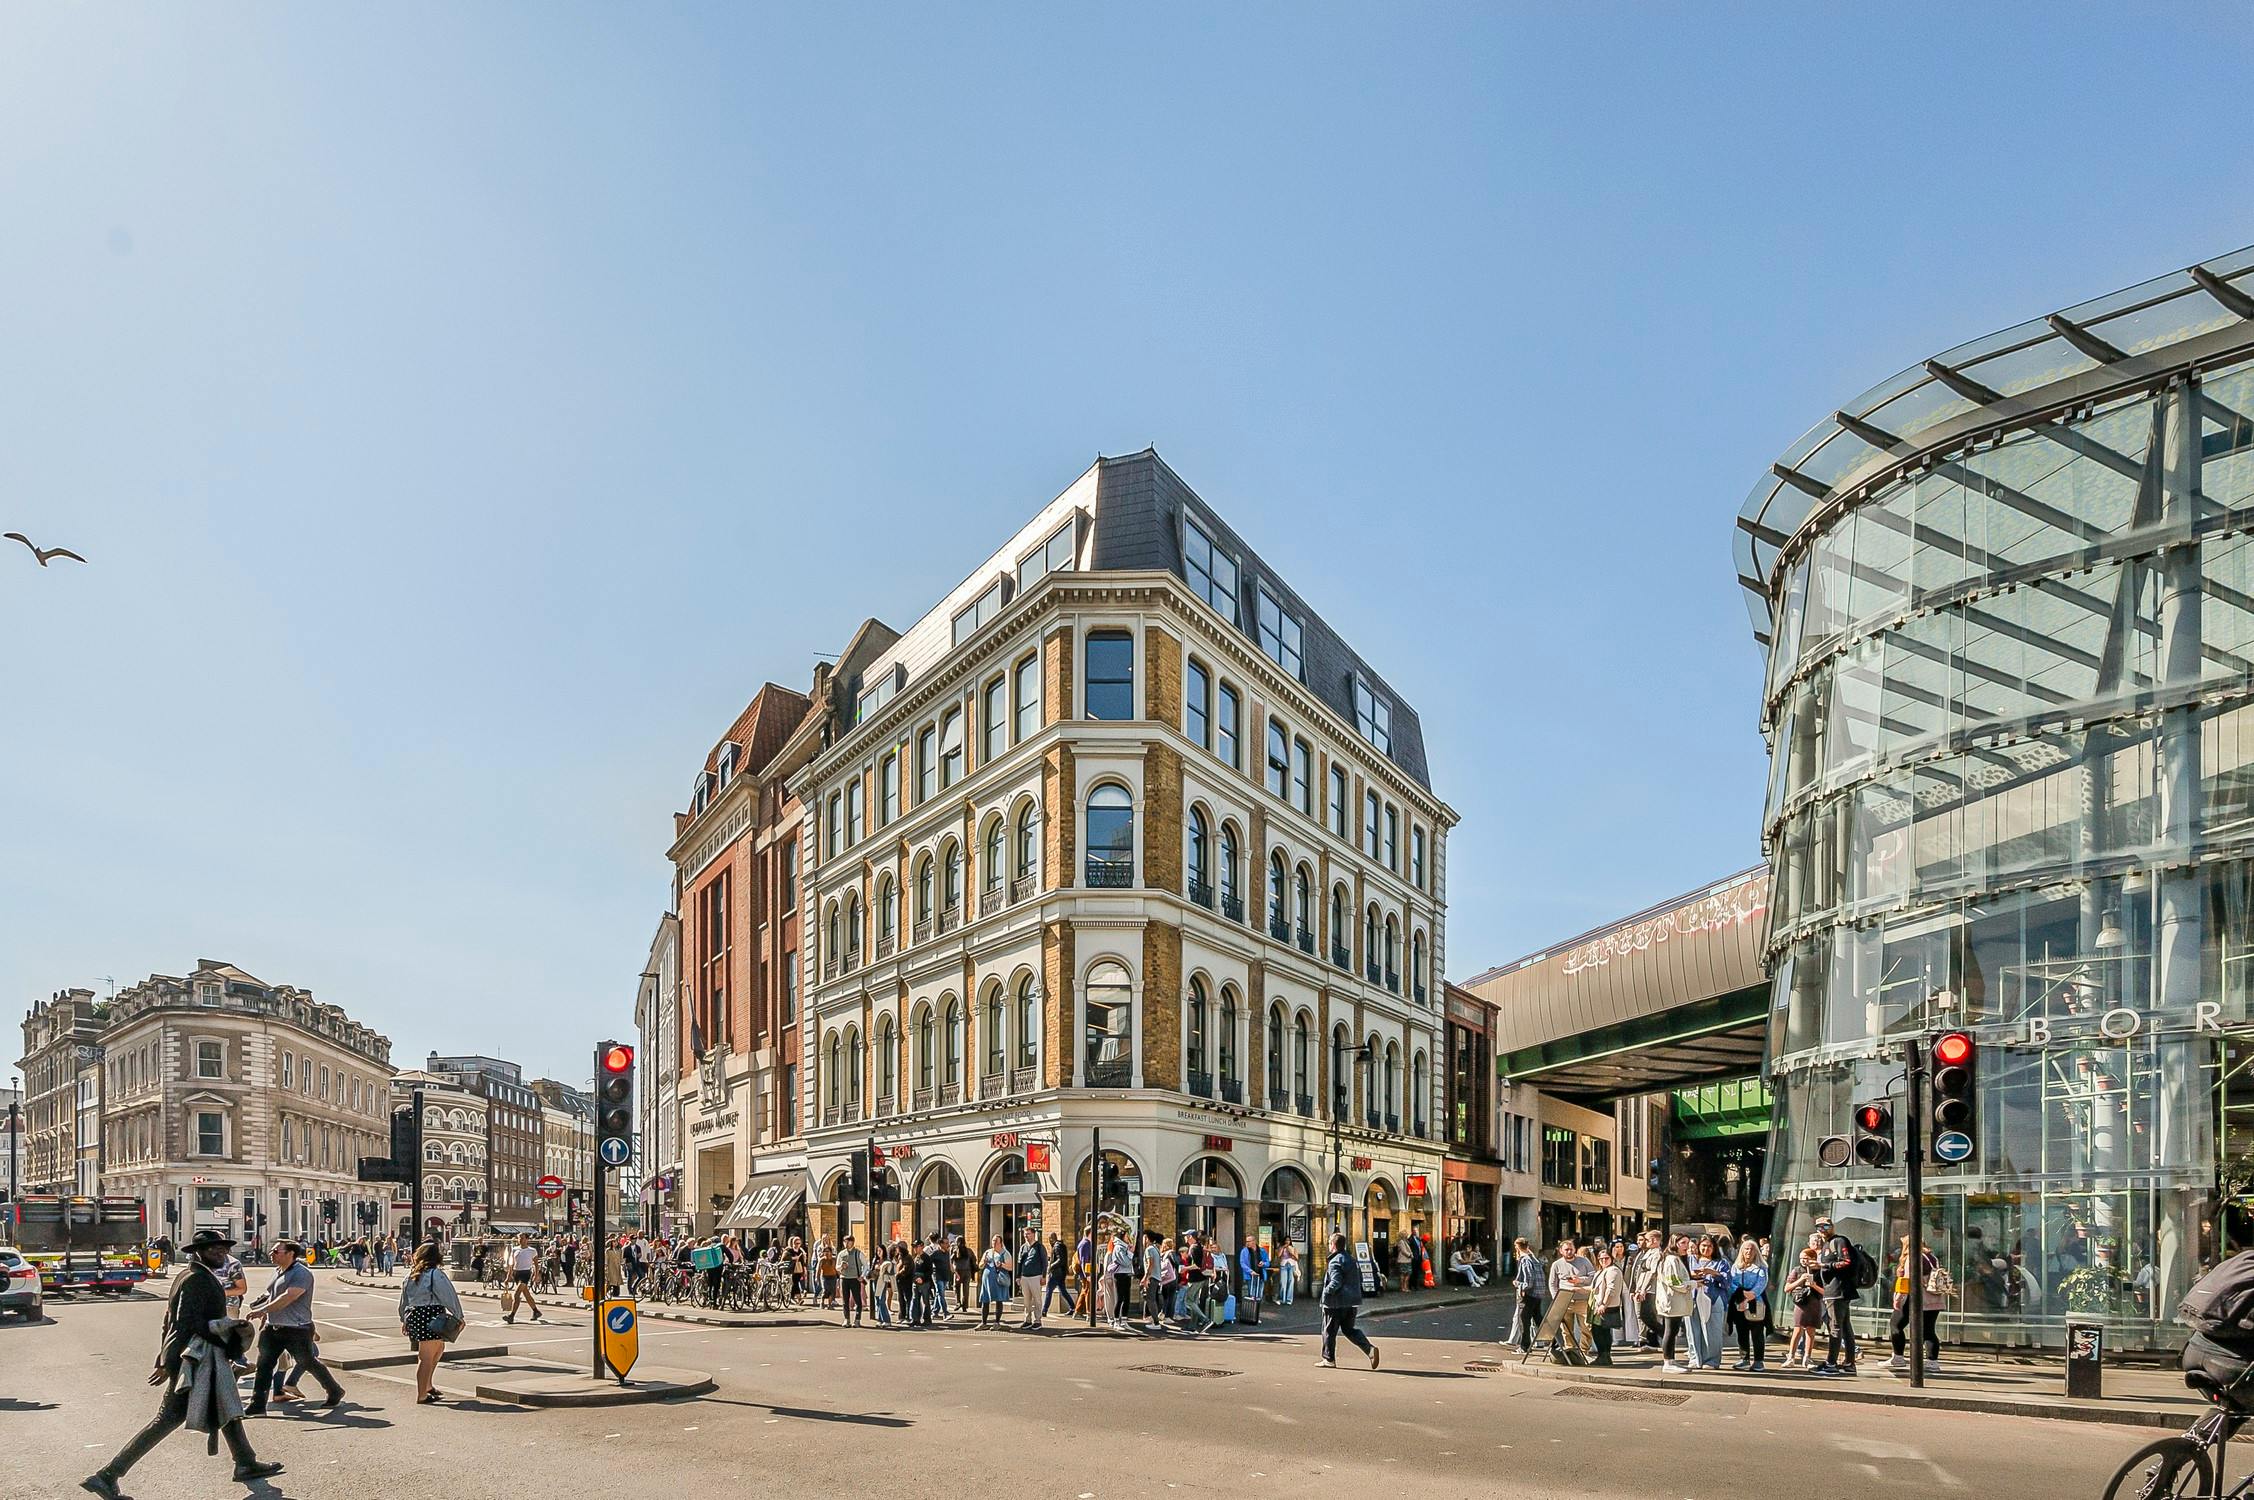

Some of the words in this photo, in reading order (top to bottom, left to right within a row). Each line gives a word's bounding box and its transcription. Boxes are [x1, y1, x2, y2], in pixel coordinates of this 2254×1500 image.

[1177, 1110, 1207, 1122] BREAKFAST
[1208, 1115, 1227, 1126] LUNCH
[988, 1132, 1018, 1149] LEON
[1029, 1162, 1047, 1170] LEON
[726, 1185, 799, 1225] PADELLA
